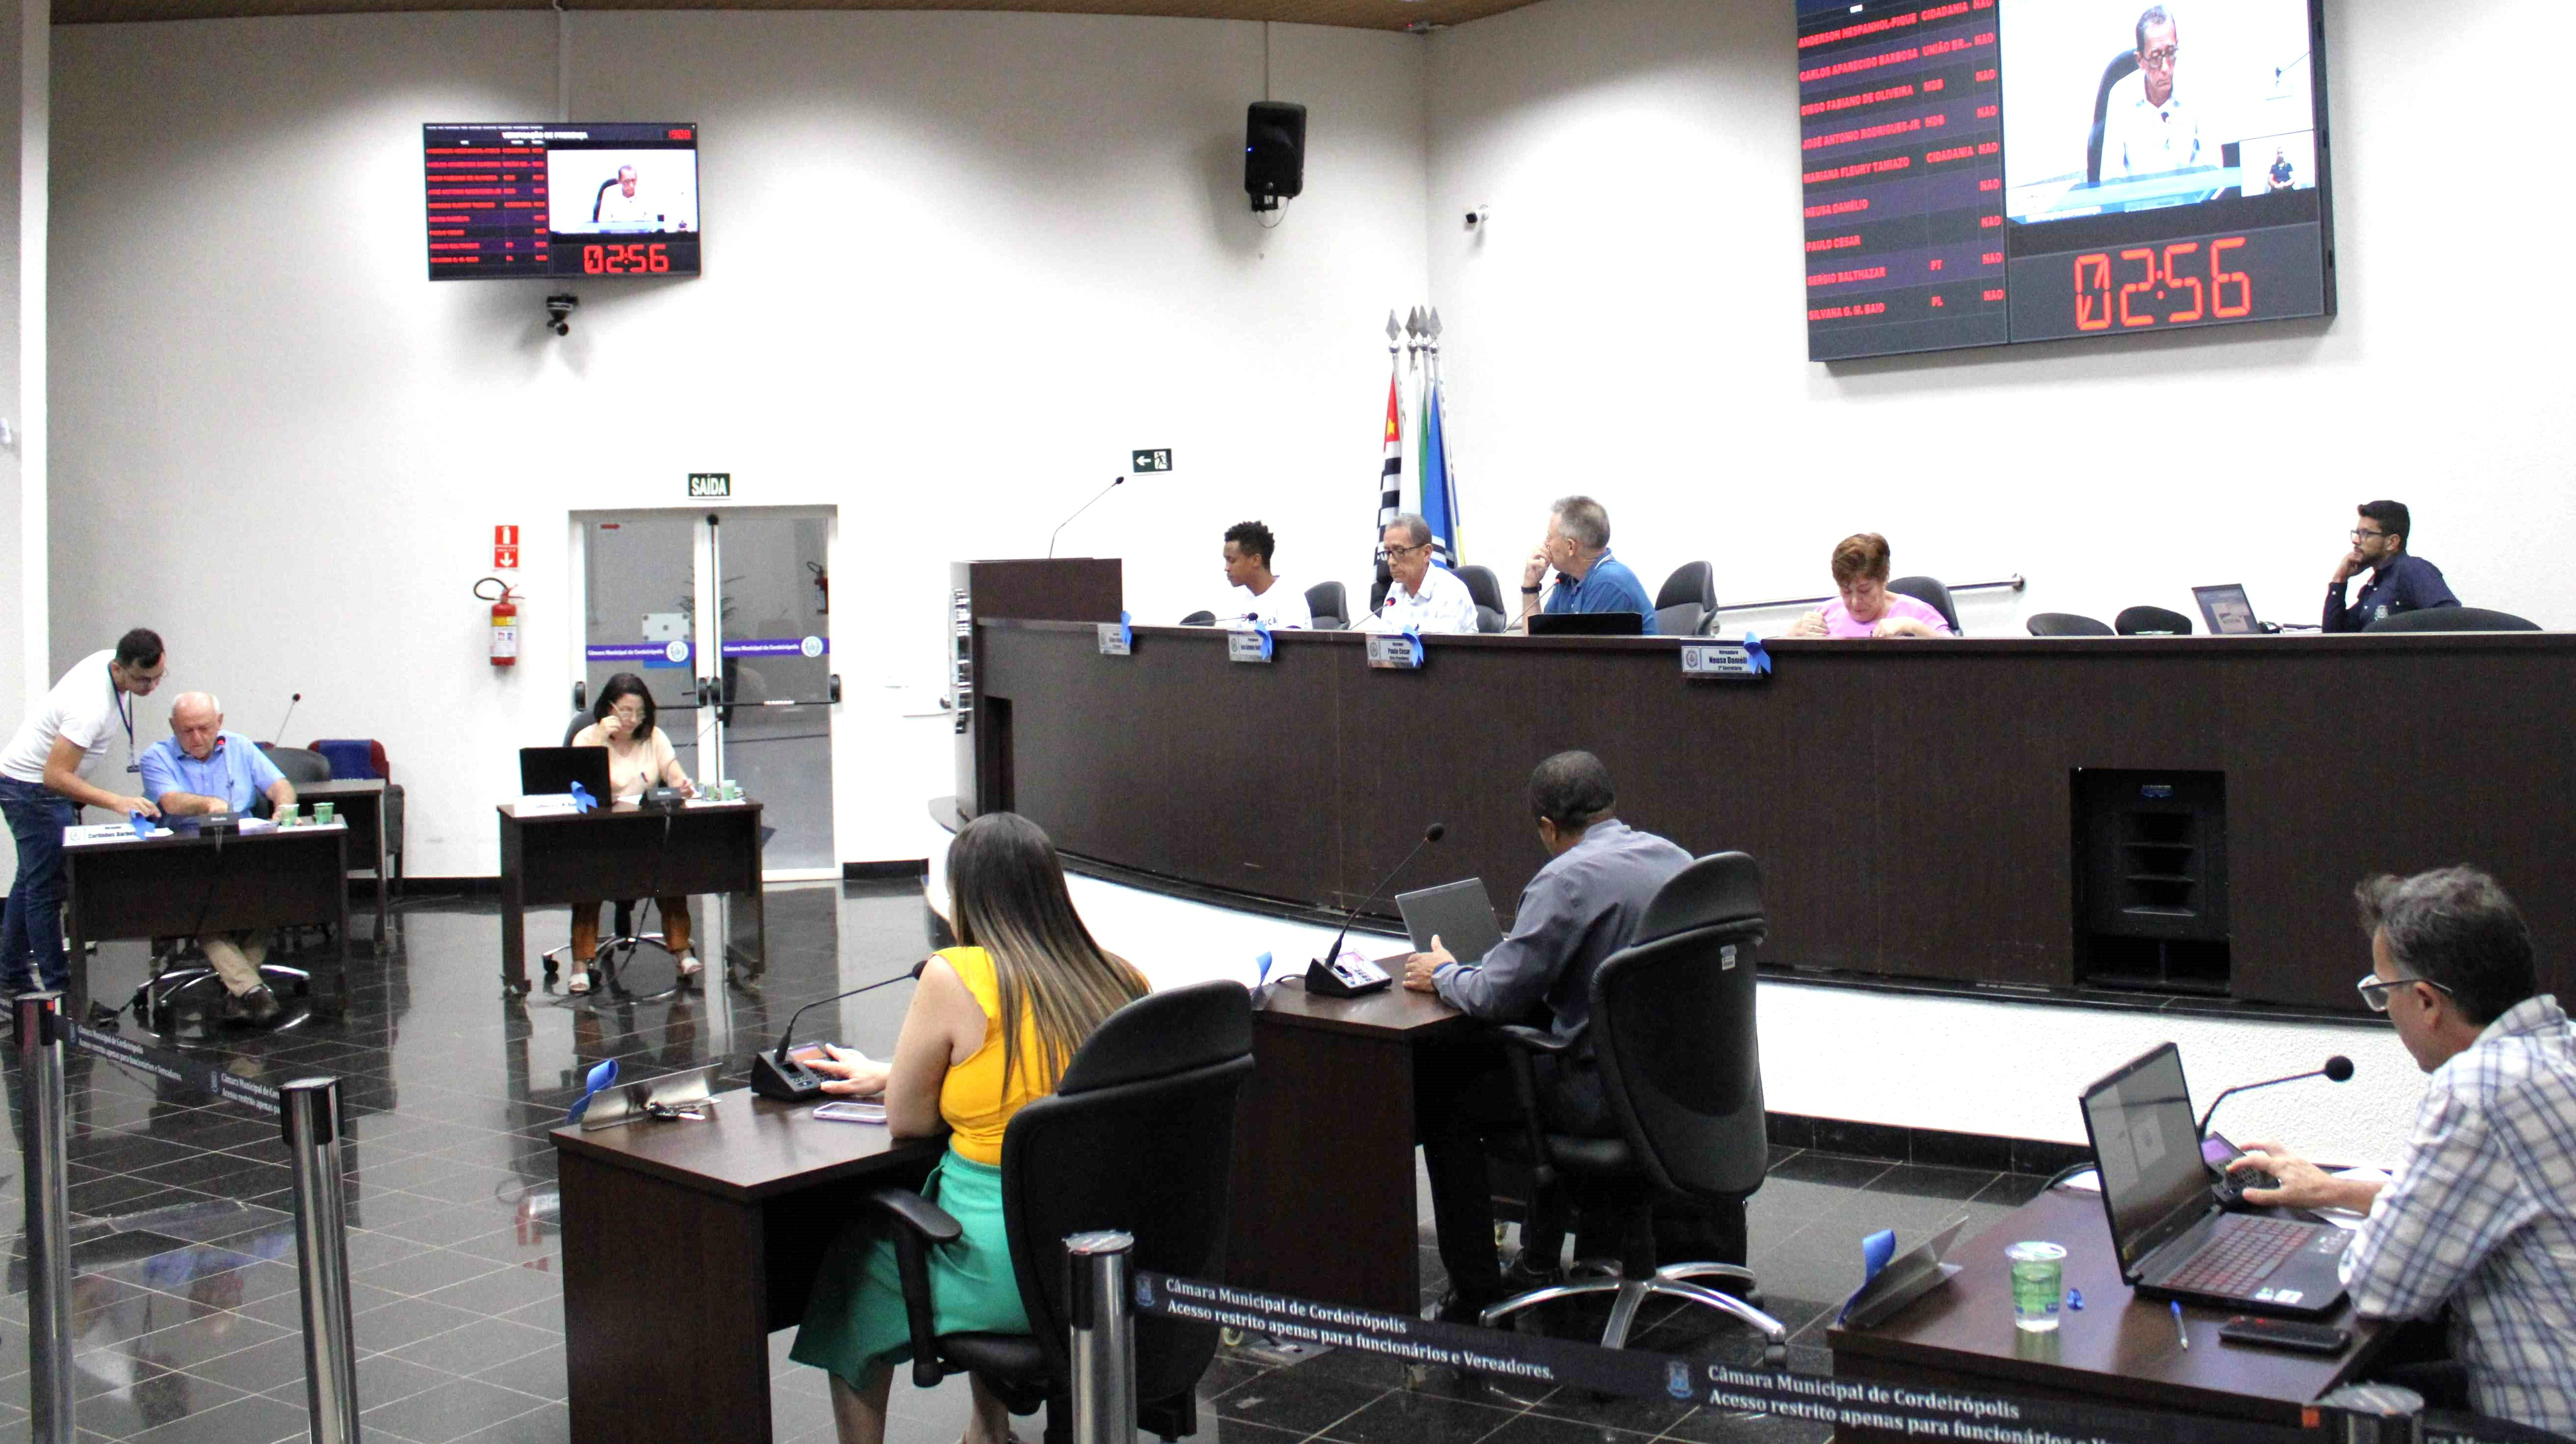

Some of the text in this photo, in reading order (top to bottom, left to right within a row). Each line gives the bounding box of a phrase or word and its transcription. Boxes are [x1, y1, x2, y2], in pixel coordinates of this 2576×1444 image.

[1799, 67, 1831, 82] CARLOS
[1831, 56, 1879, 75] APARECIDO
[1879, 48, 1919, 66] BARBOSA
[1800, 102, 1826, 116] DIEGO
[1825, 95, 1862, 110] FABIANO
[1862, 92, 1875, 104] DE
[1875, 85, 1915, 102] OLIVEIRA
[1823, 130, 1860, 146] ANTONIO
[1803, 169, 1840, 183] MARIANA
[1804, 205, 1832, 217] NEUSA
[1805, 239, 1833, 252] PAULO
[1981, 216, 2002, 228] NAO
[583, 244, 669, 274] 02:56
[1837, 267, 1886, 282] BALTHAZAR
[1929, 259, 1943, 271] PT
[1982, 253, 2004, 265] NAO
[2074, 237, 2251, 331] 02:56
[1808, 308, 1843, 320] SILVANA
[1931, 296, 1944, 307] PL
[1983, 289, 2005, 301] NAO
[692, 474, 727, 495] SAÍDA
[1166, 1278, 1406, 1334] Câmara Municipal de Cordeirópolis
[1167, 1299, 1554, 1380] Acesso restrito apenas para funcionários e Vereadores.
[1708, 1365, 2020, 1419] Câmara Municipal de Cordeirópolis
[1709, 1388, 1767, 1411] Acesso
[1770, 1399, 1837, 1422] restrito
[1840, 1410, 1904, 1430] apenas
[1908, 1417, 1949, 1436] para
